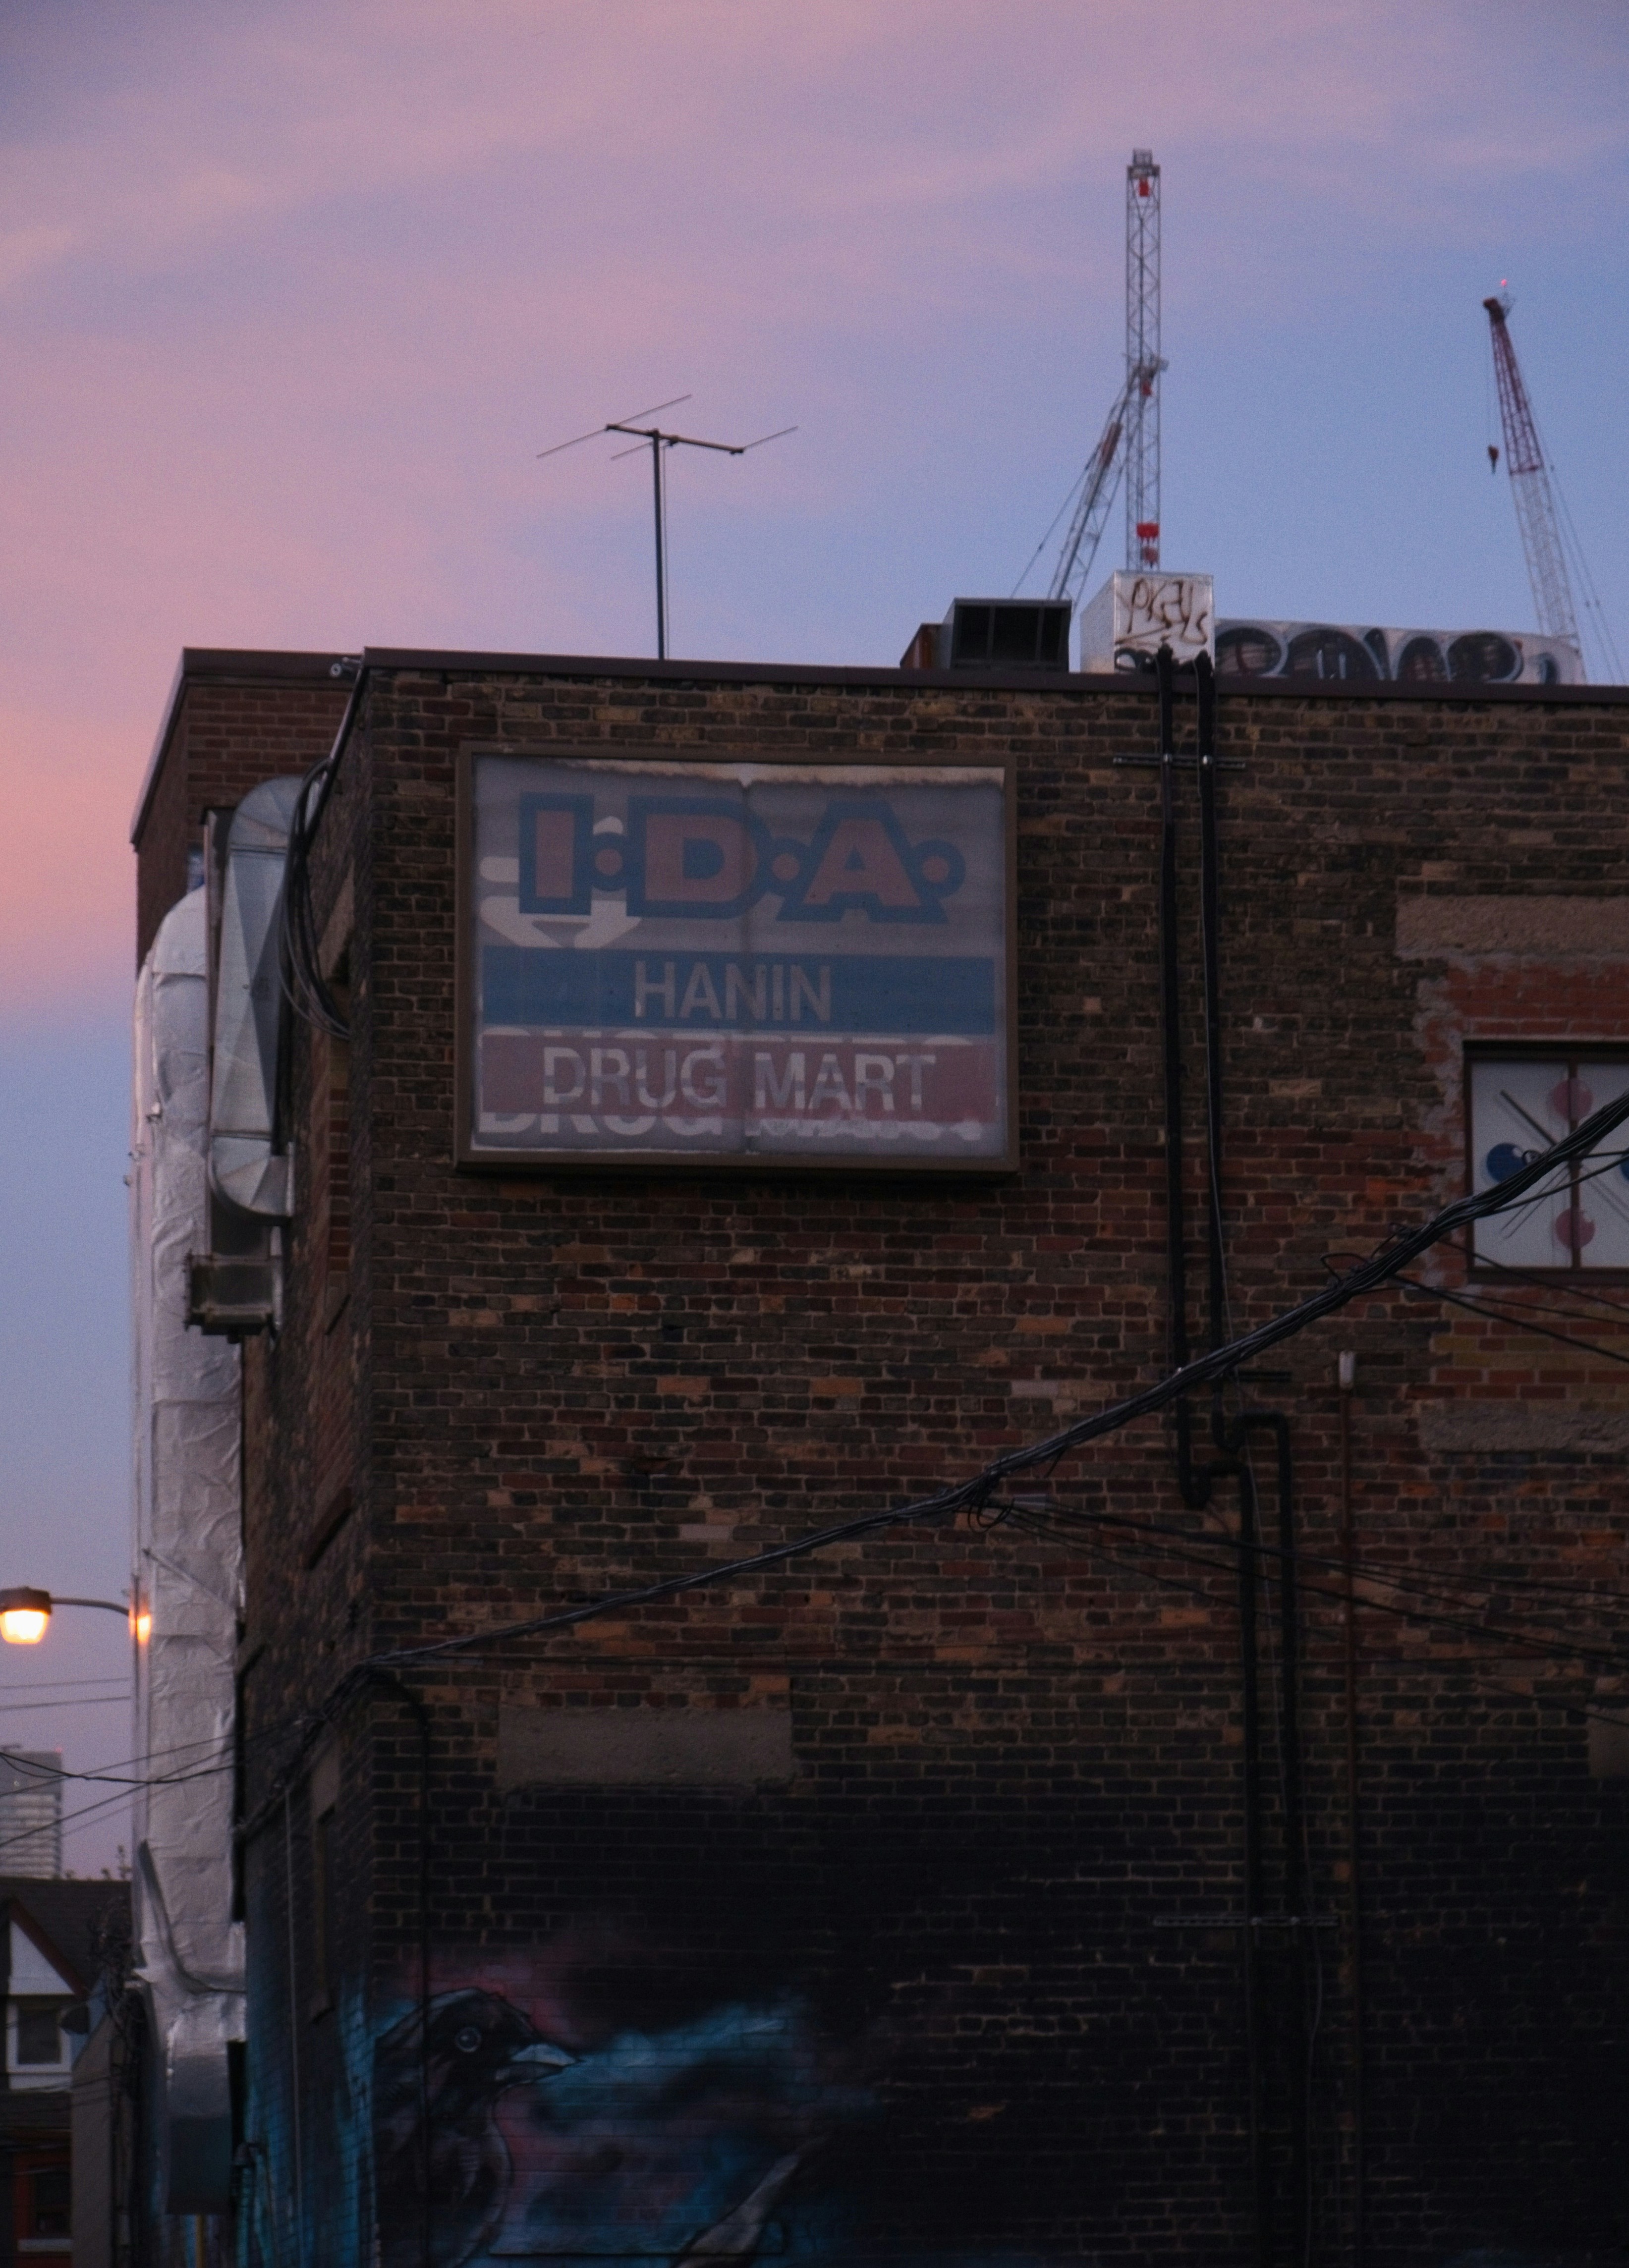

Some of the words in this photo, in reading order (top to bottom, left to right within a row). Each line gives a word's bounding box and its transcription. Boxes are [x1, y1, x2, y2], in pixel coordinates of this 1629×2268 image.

[635, 960, 830, 1021] HANIN
[543, 1046, 727, 1108] DRUG
[754, 1051, 937, 1111] MART
